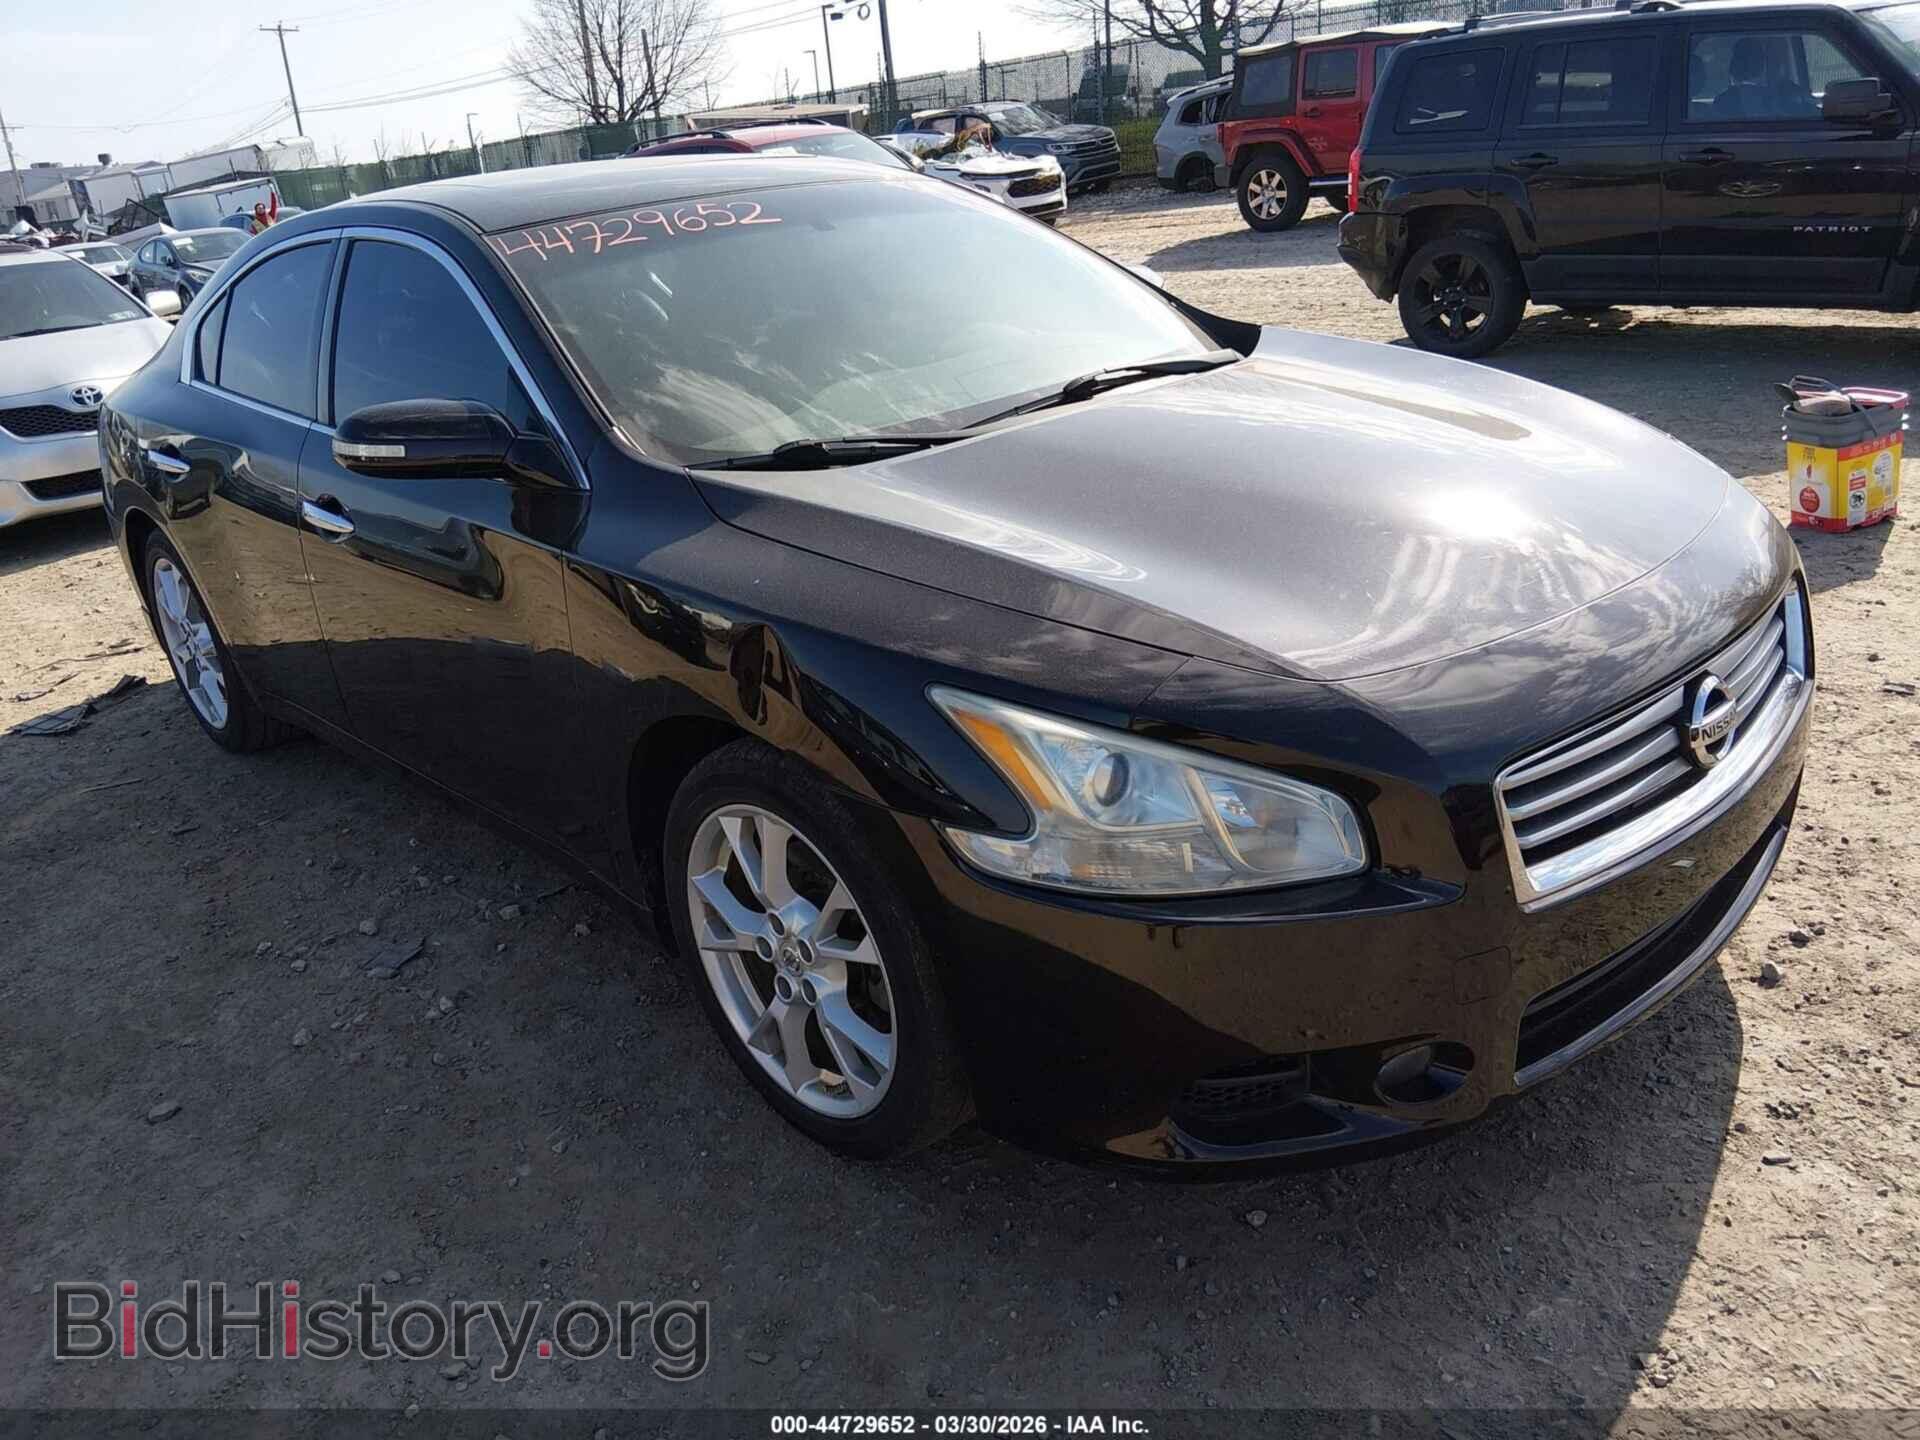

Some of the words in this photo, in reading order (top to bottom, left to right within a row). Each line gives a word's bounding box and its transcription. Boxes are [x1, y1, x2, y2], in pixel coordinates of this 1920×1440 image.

[497, 202, 782, 261] 44729652
[1792, 225, 1872, 233] PATRIOT
[1700, 711, 1735, 742] NISSA
